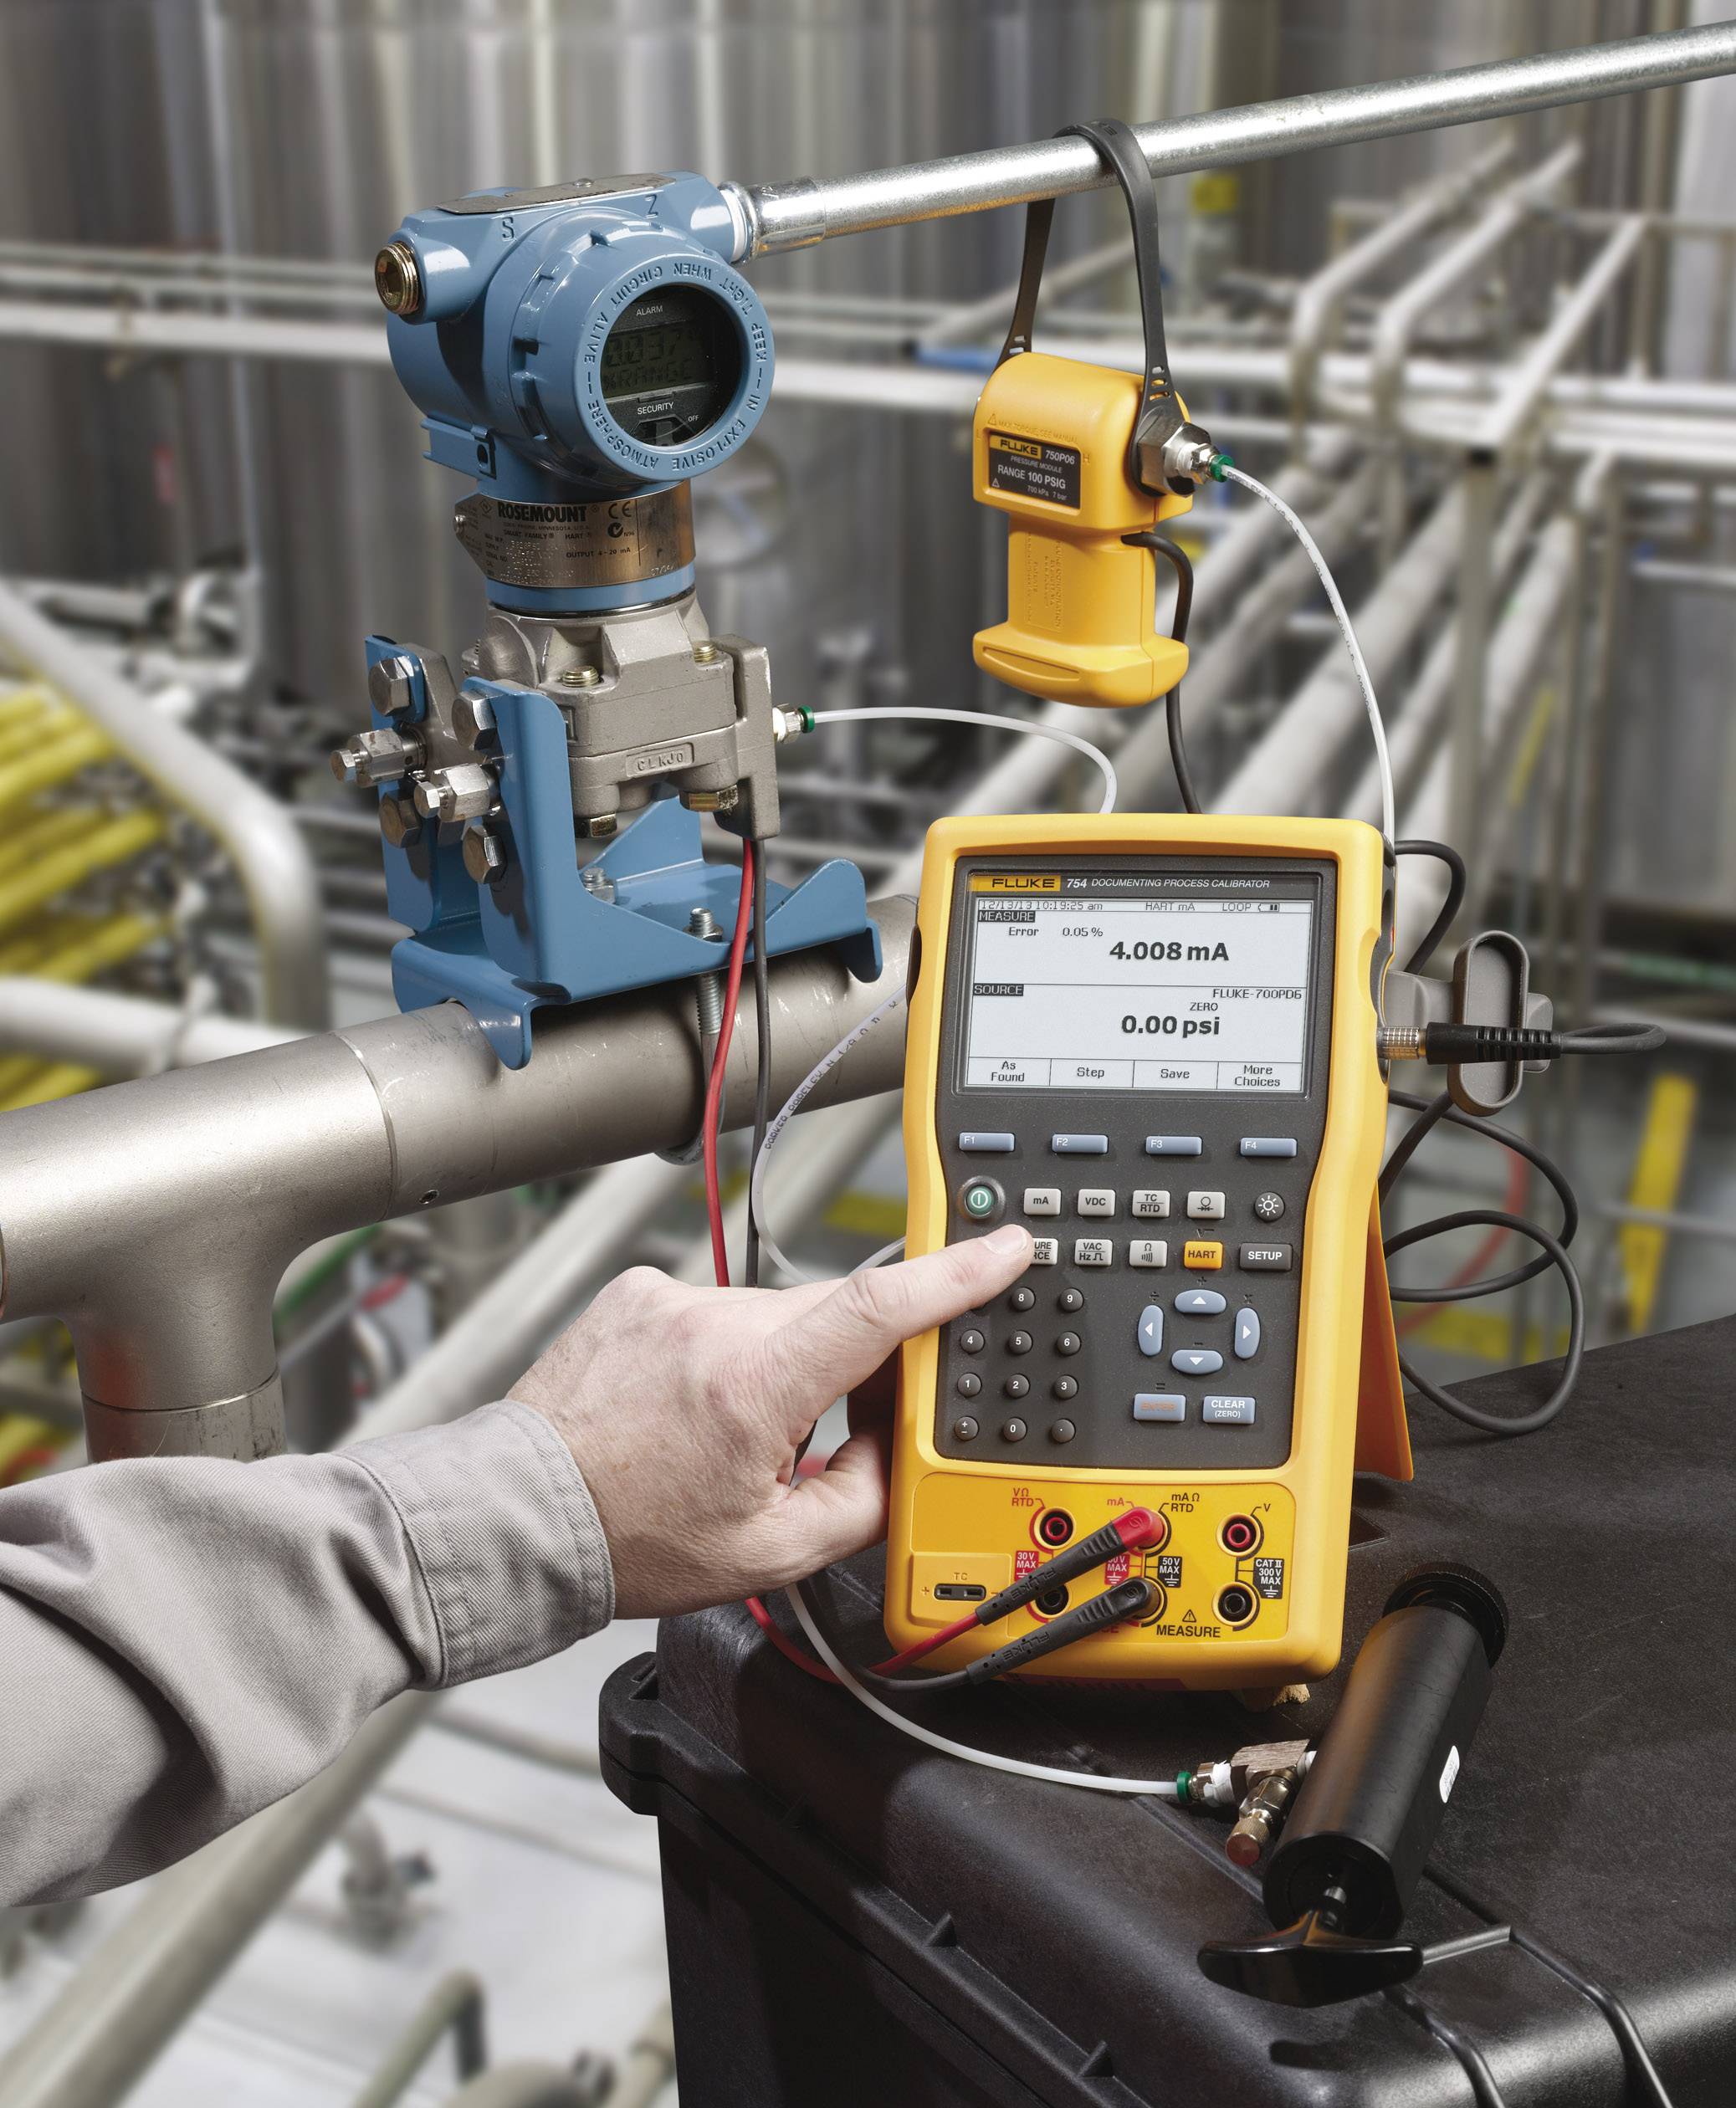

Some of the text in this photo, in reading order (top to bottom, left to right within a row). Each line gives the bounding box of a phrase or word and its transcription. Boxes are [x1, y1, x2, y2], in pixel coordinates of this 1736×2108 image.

[584, 262, 767, 364] KEEP TIGHT WHEN CIRCUIT ALIVE
[637, 305, 663, 316] ALARM
[637, 402, 674, 415] SECURITY
[587, 394, 760, 470] IN EXPLOSIVE ATMOSPHERE
[1000, 439, 1075, 464] FLUKE 750P06
[1011, 456, 1063, 473] PRESSURE MODULE
[997, 464, 1066, 489] RANGE 100 PSIG
[1027, 485, 1037, 494] 700
[497, 502, 586, 523] ROSEMOUNT
[566, 550, 594, 559] OUTPUT
[992, 878, 1270, 888] FLUKE 754 DOCUMENTING PROCESS CALIBRATOR
[981, 901, 1032, 910] 12/13/13
[1036, 901, 1083, 911] 10:19:25
[1145, 903, 1174, 911] HART
[1178, 903, 1195, 911] mA
[1222, 903, 1252, 912] LOOP
[979, 911, 1034, 922] MEASURE
[1008, 927, 1103, 937] Error 0.05 %
[1109, 942, 1229, 961] 4.008 mA
[974, 985, 1023, 995] SOURCE
[1190, 1002, 1218, 1011] ZERO
[1121, 1015, 1220, 1038] 0.00 psi
[1001, 1061, 1016, 1071] As
[1243, 1065, 1273, 1075] More
[991, 1072, 1025, 1082] Found
[1077, 1067, 1104, 1079] Step
[1160, 1068, 1191, 1079] Save
[1234, 1077, 1281, 1087] Choices
[964, 1136, 976, 1144] F1
[1057, 1138, 1068, 1146] F2
[1150, 1140, 1163, 1149] F3
[1033, 1196, 1049, 1205] mA
[1084, 1198, 1106, 1206] VDC
[1145, 1194, 1158, 1202] TC
[1140, 1205, 1160, 1214] RTD
[1083, 1242, 1102, 1251] VAC
[1188, 1251, 1216, 1259] HART
[1247, 1251, 1283, 1261] SETUP
[1018, 1294, 1025, 1302] 8
[1067, 1294, 1073, 1302] 9
[967, 1336, 974, 1344] 4
[1015, 1337, 1022, 1345] 5
[1063, 1338, 1070, 1347] 6
[965, 1379, 970, 1388] 1
[1012, 1380, 1019, 1389] 2
[1061, 1382, 1068, 1390] 3
[1211, 1400, 1246, 1409] CLEAR
[1215, 1410, 1241, 1419] (ZERO)
[1010, 1425, 1017, 1433] 0
[1107, 1497, 1124, 1506] mA
[1171, 1492, 1188, 1502] mA
[1011, 1497, 1034, 1507] RTD
[1170, 1503, 1194, 1512] RTD
[1263, 1503, 1271, 1512] V
[1017, 1560, 1037, 1568] MAX
[1108, 1563, 1128, 1573] MAX
[1256, 1559, 1273, 1568] CAT
[1160, 1566, 1180, 1574] MAX
[1274, 1568, 1282, 1577] V
[954, 1573, 968, 1581] TC
[1260, 1576, 1281, 1585] MAX
[1011, 1568, 1057, 1600] FLUKE
[1156, 1624, 1221, 1638] MEASURE
[1003, 1631, 1050, 1660] FLUKE
